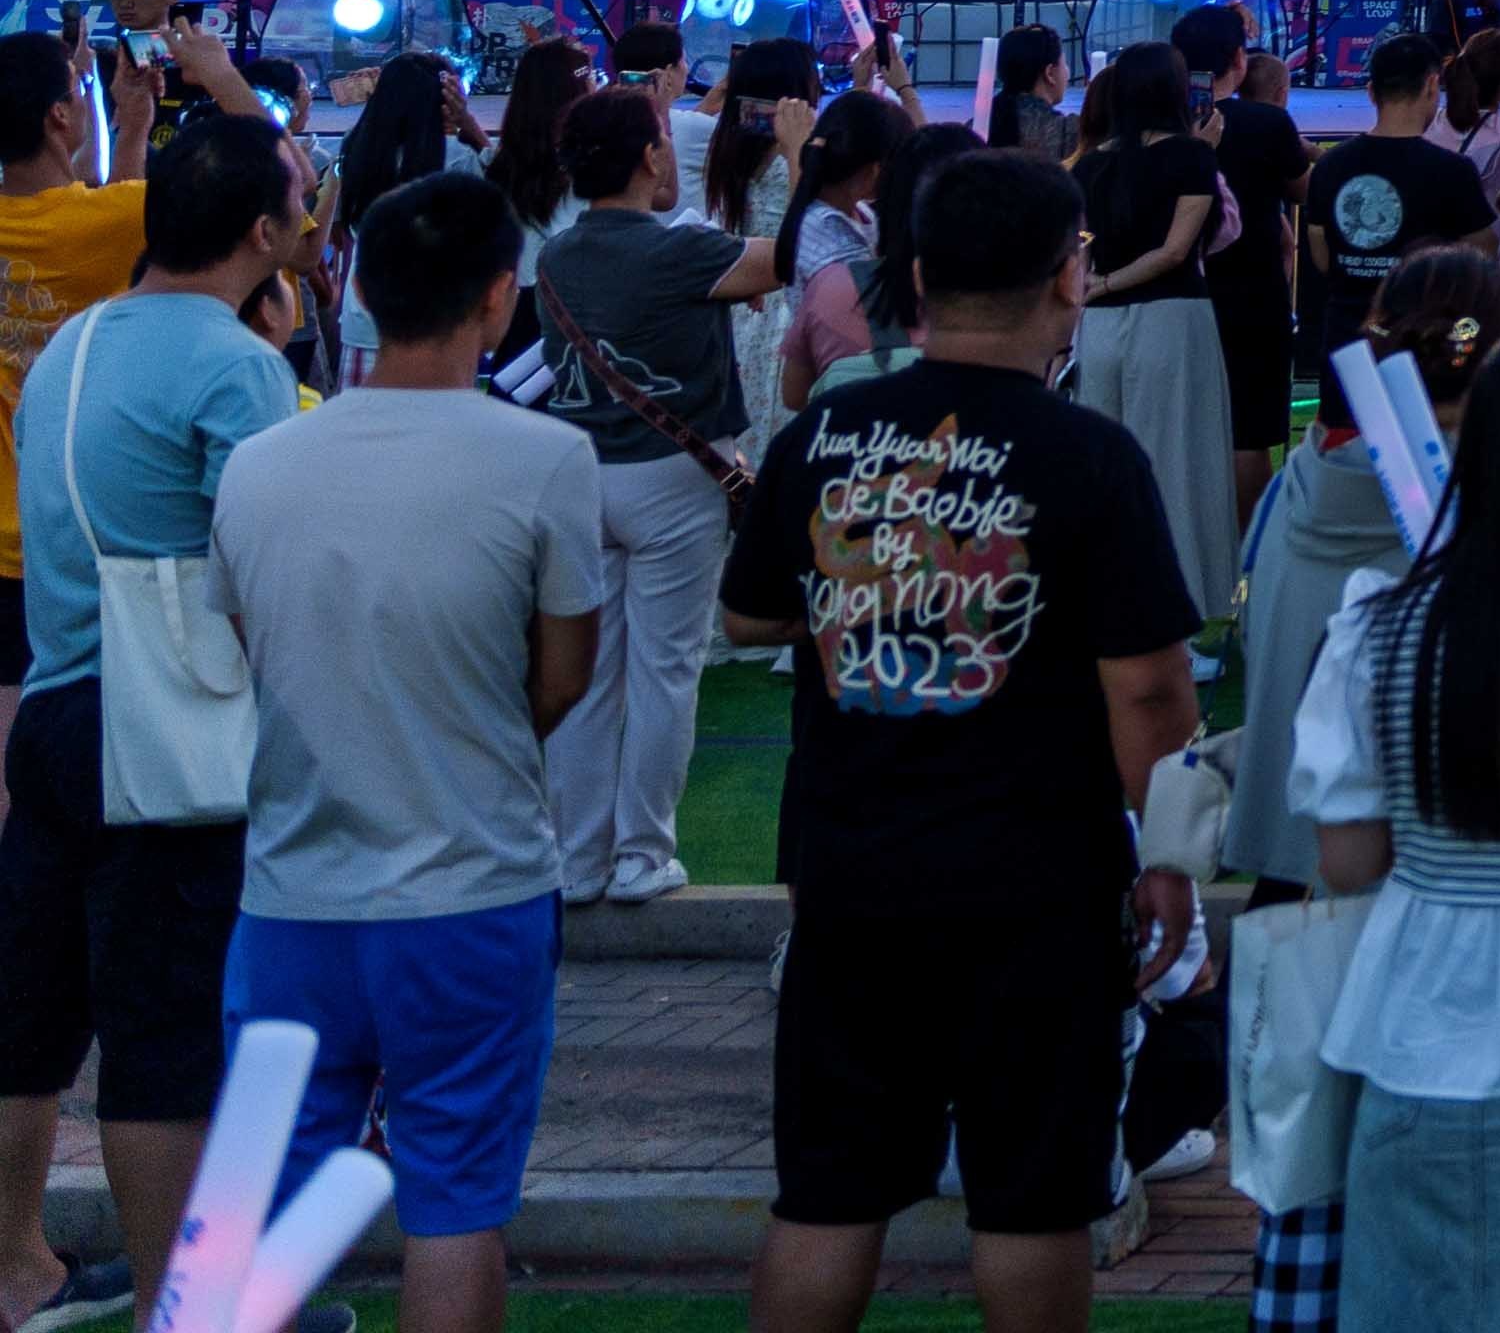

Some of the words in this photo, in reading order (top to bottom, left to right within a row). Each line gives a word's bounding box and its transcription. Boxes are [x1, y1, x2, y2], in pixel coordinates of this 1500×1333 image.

[1363, 0, 1398, 10] SPACE
[1366, 9, 1393, 18] LOOP
[837, 632, 996, 698] 2023
